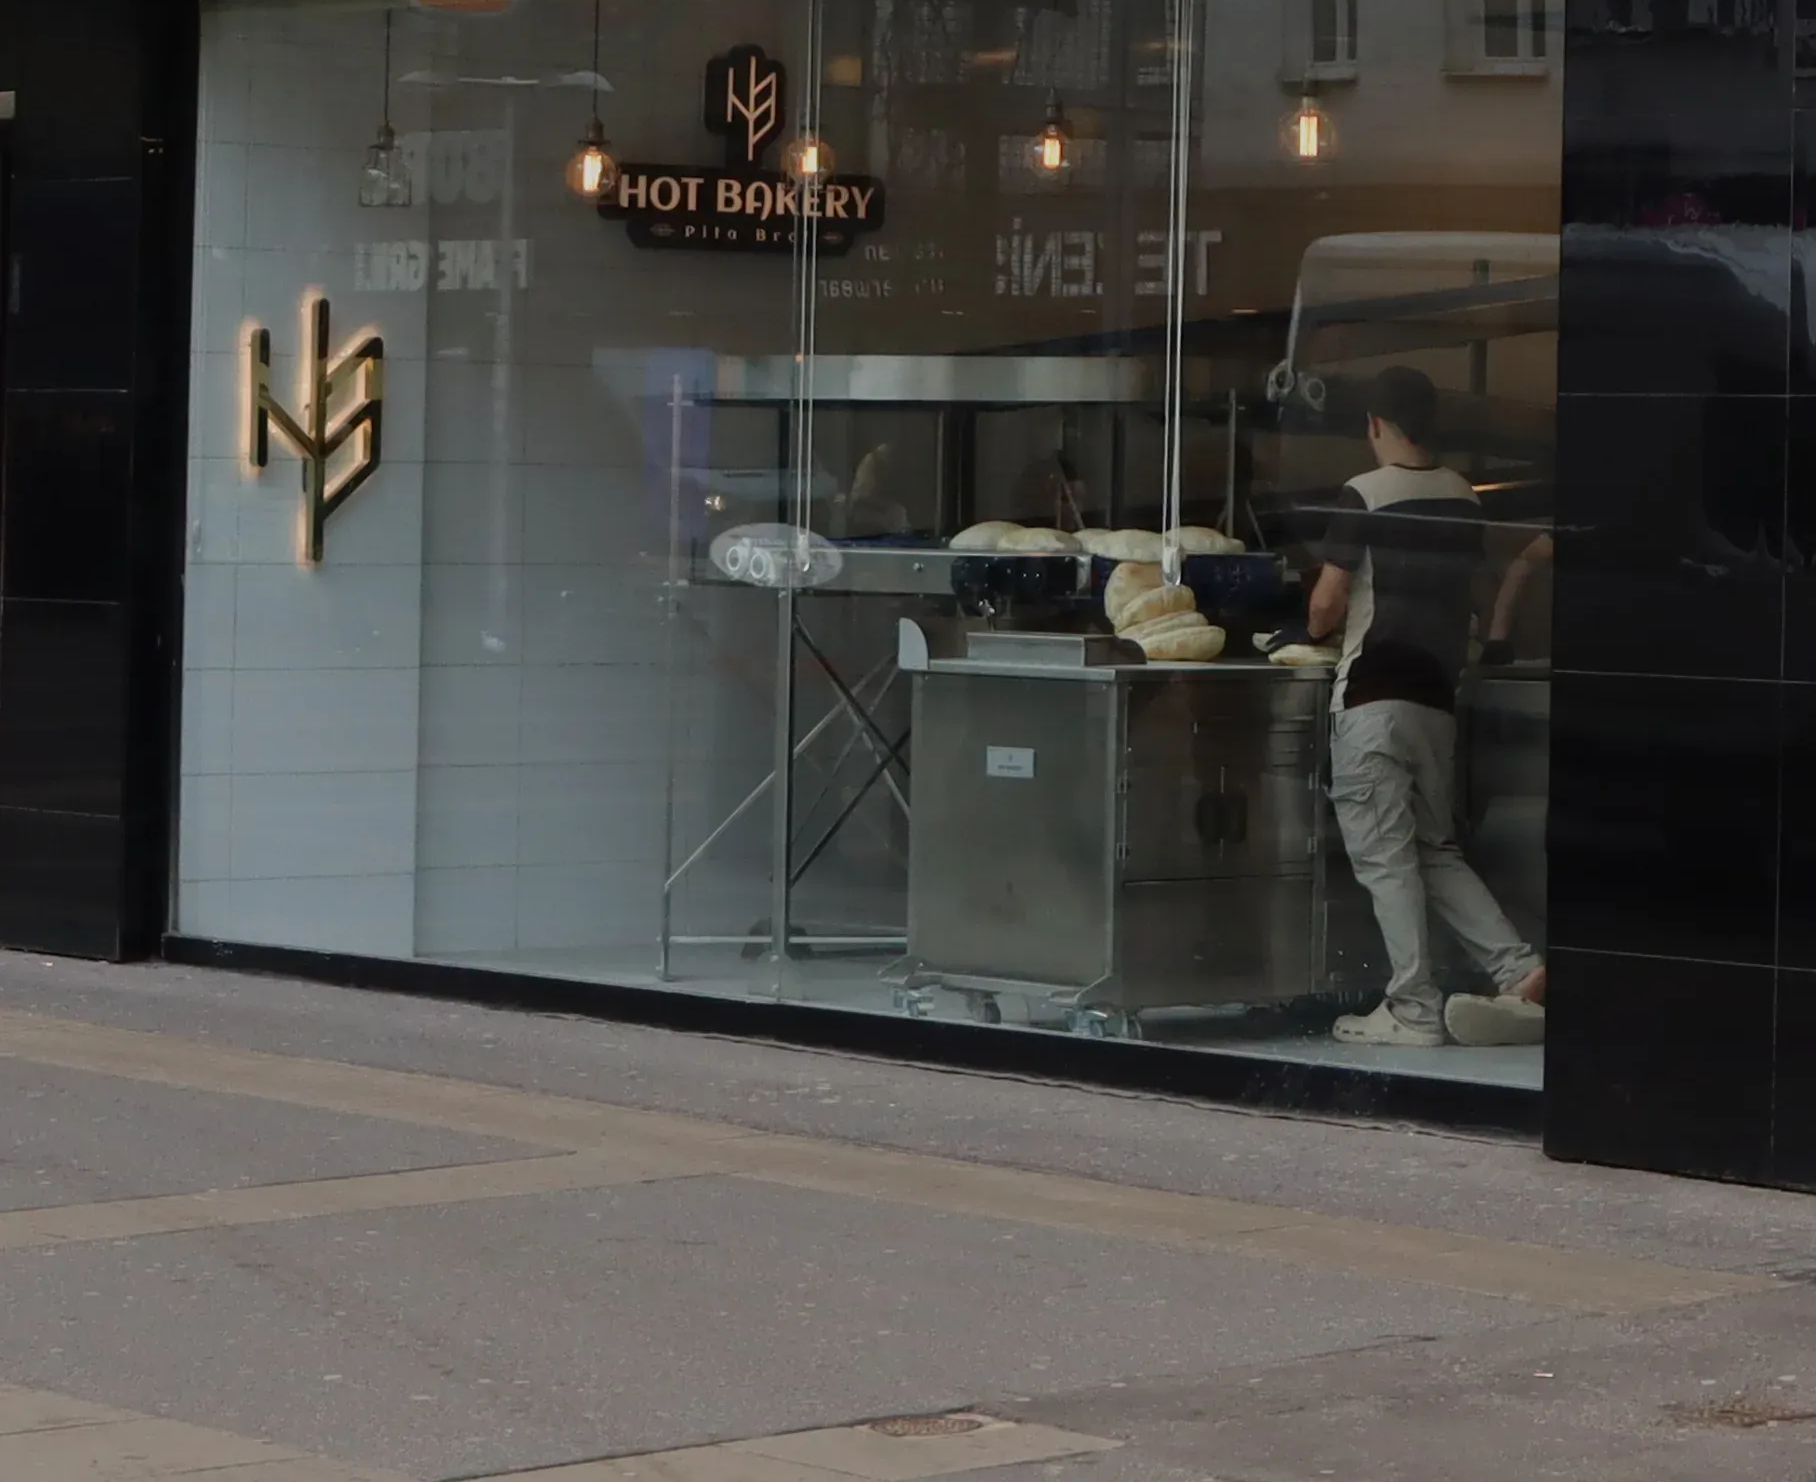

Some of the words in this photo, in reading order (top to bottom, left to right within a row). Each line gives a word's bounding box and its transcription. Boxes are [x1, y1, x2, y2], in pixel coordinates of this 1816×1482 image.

[618, 174, 704, 212] HOT
[716, 178, 875, 221] BAKERY
[684, 224, 738, 240] Pita
